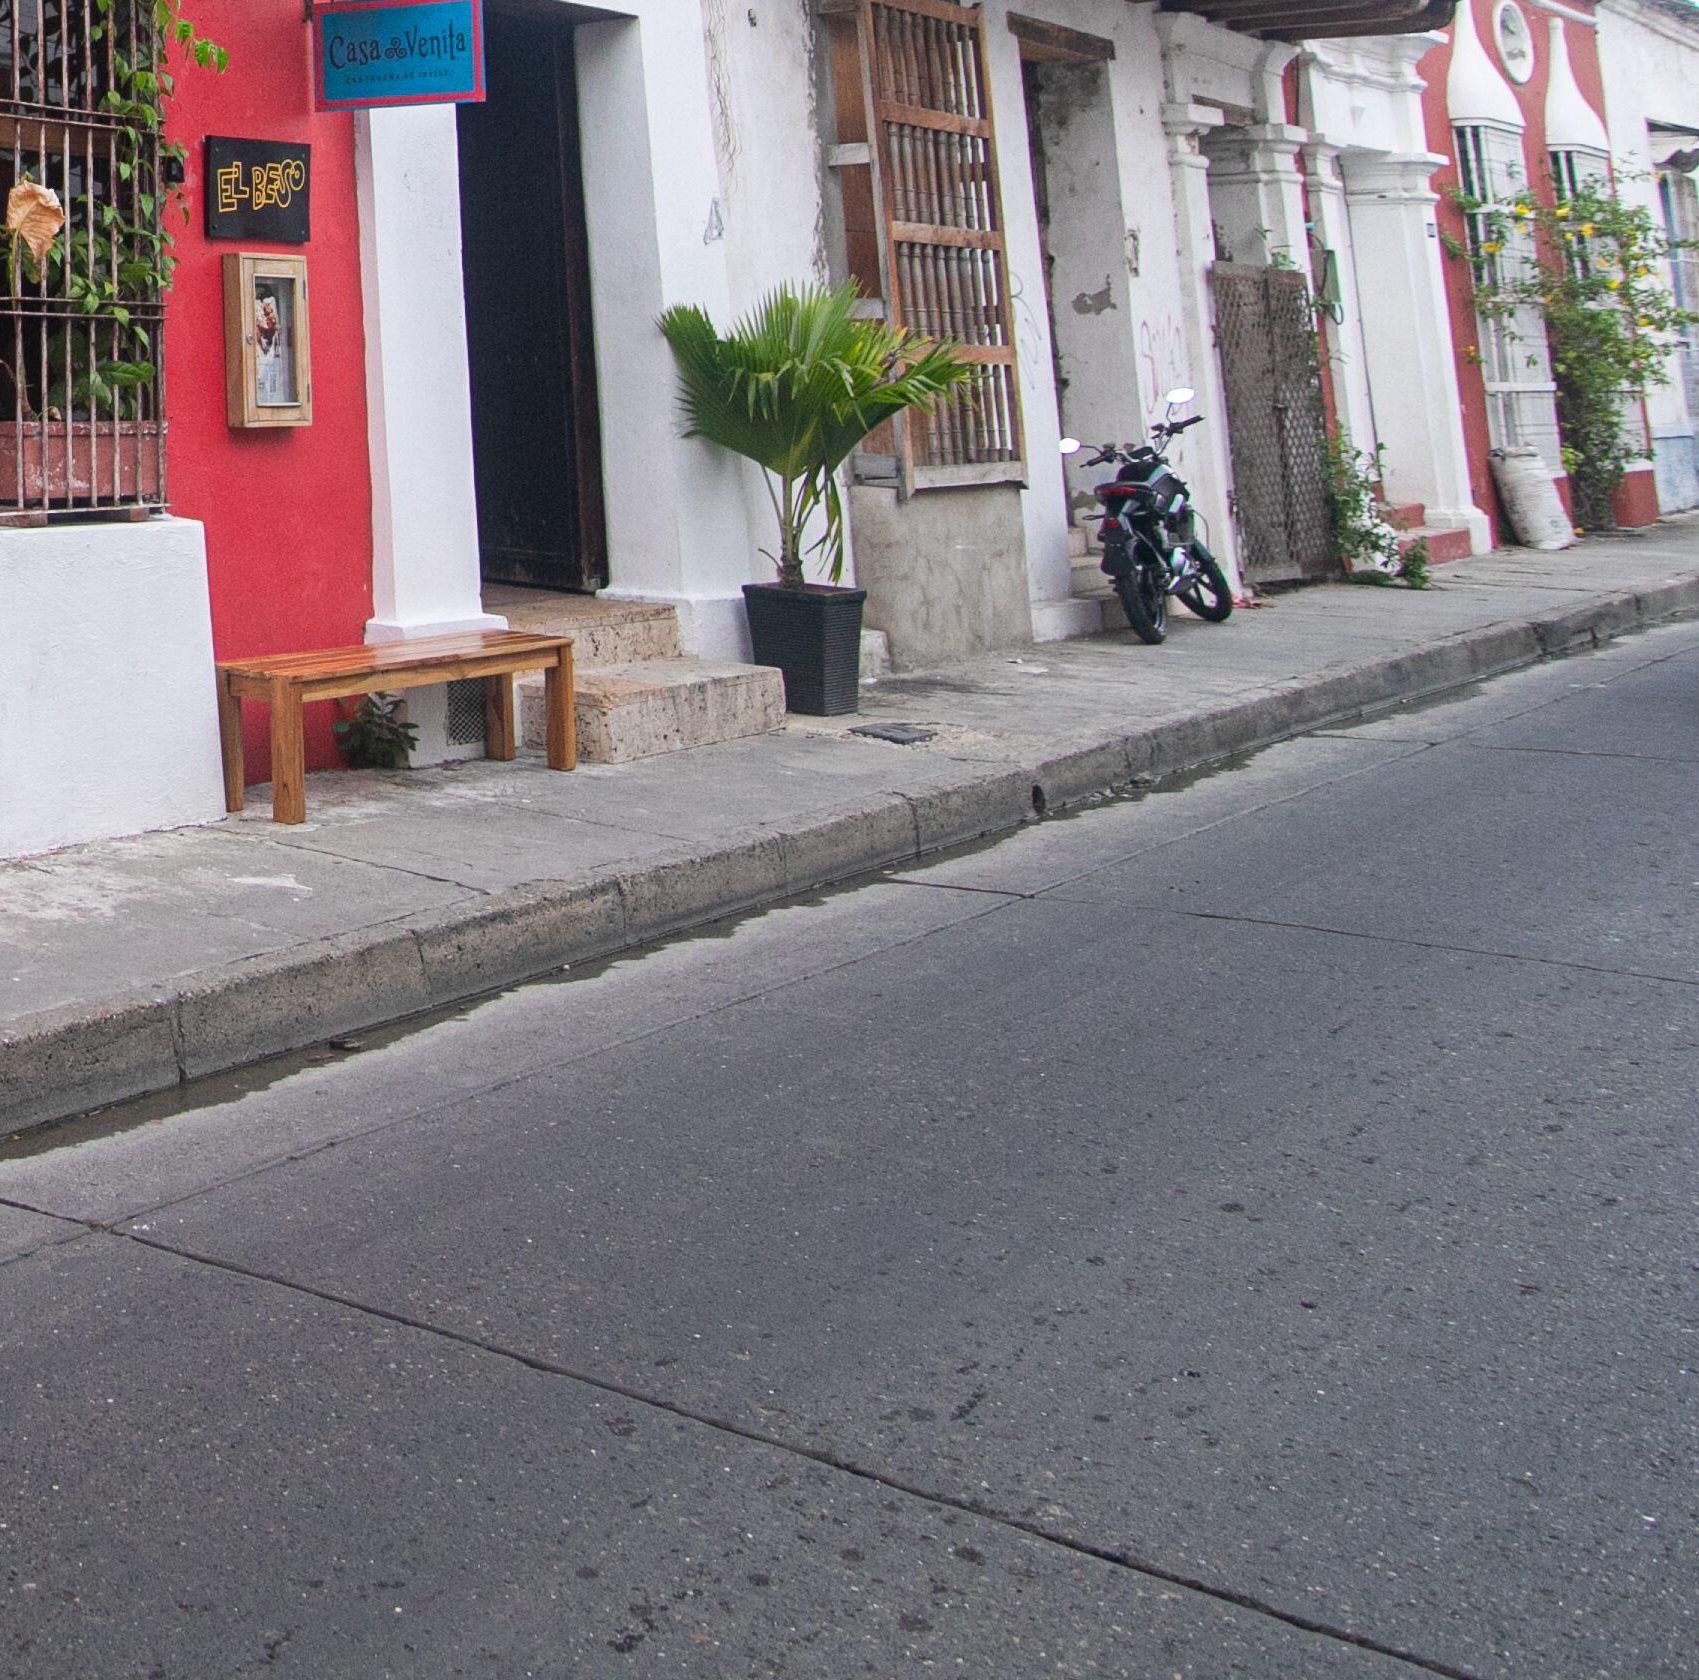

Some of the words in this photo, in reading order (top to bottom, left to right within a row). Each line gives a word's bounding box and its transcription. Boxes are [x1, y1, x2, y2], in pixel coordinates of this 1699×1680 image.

[329, 35, 381, 70] Casa
[403, 20, 467, 61] Venita
[217, 161, 250, 213] EL
[251, 158, 306, 211] BESO
